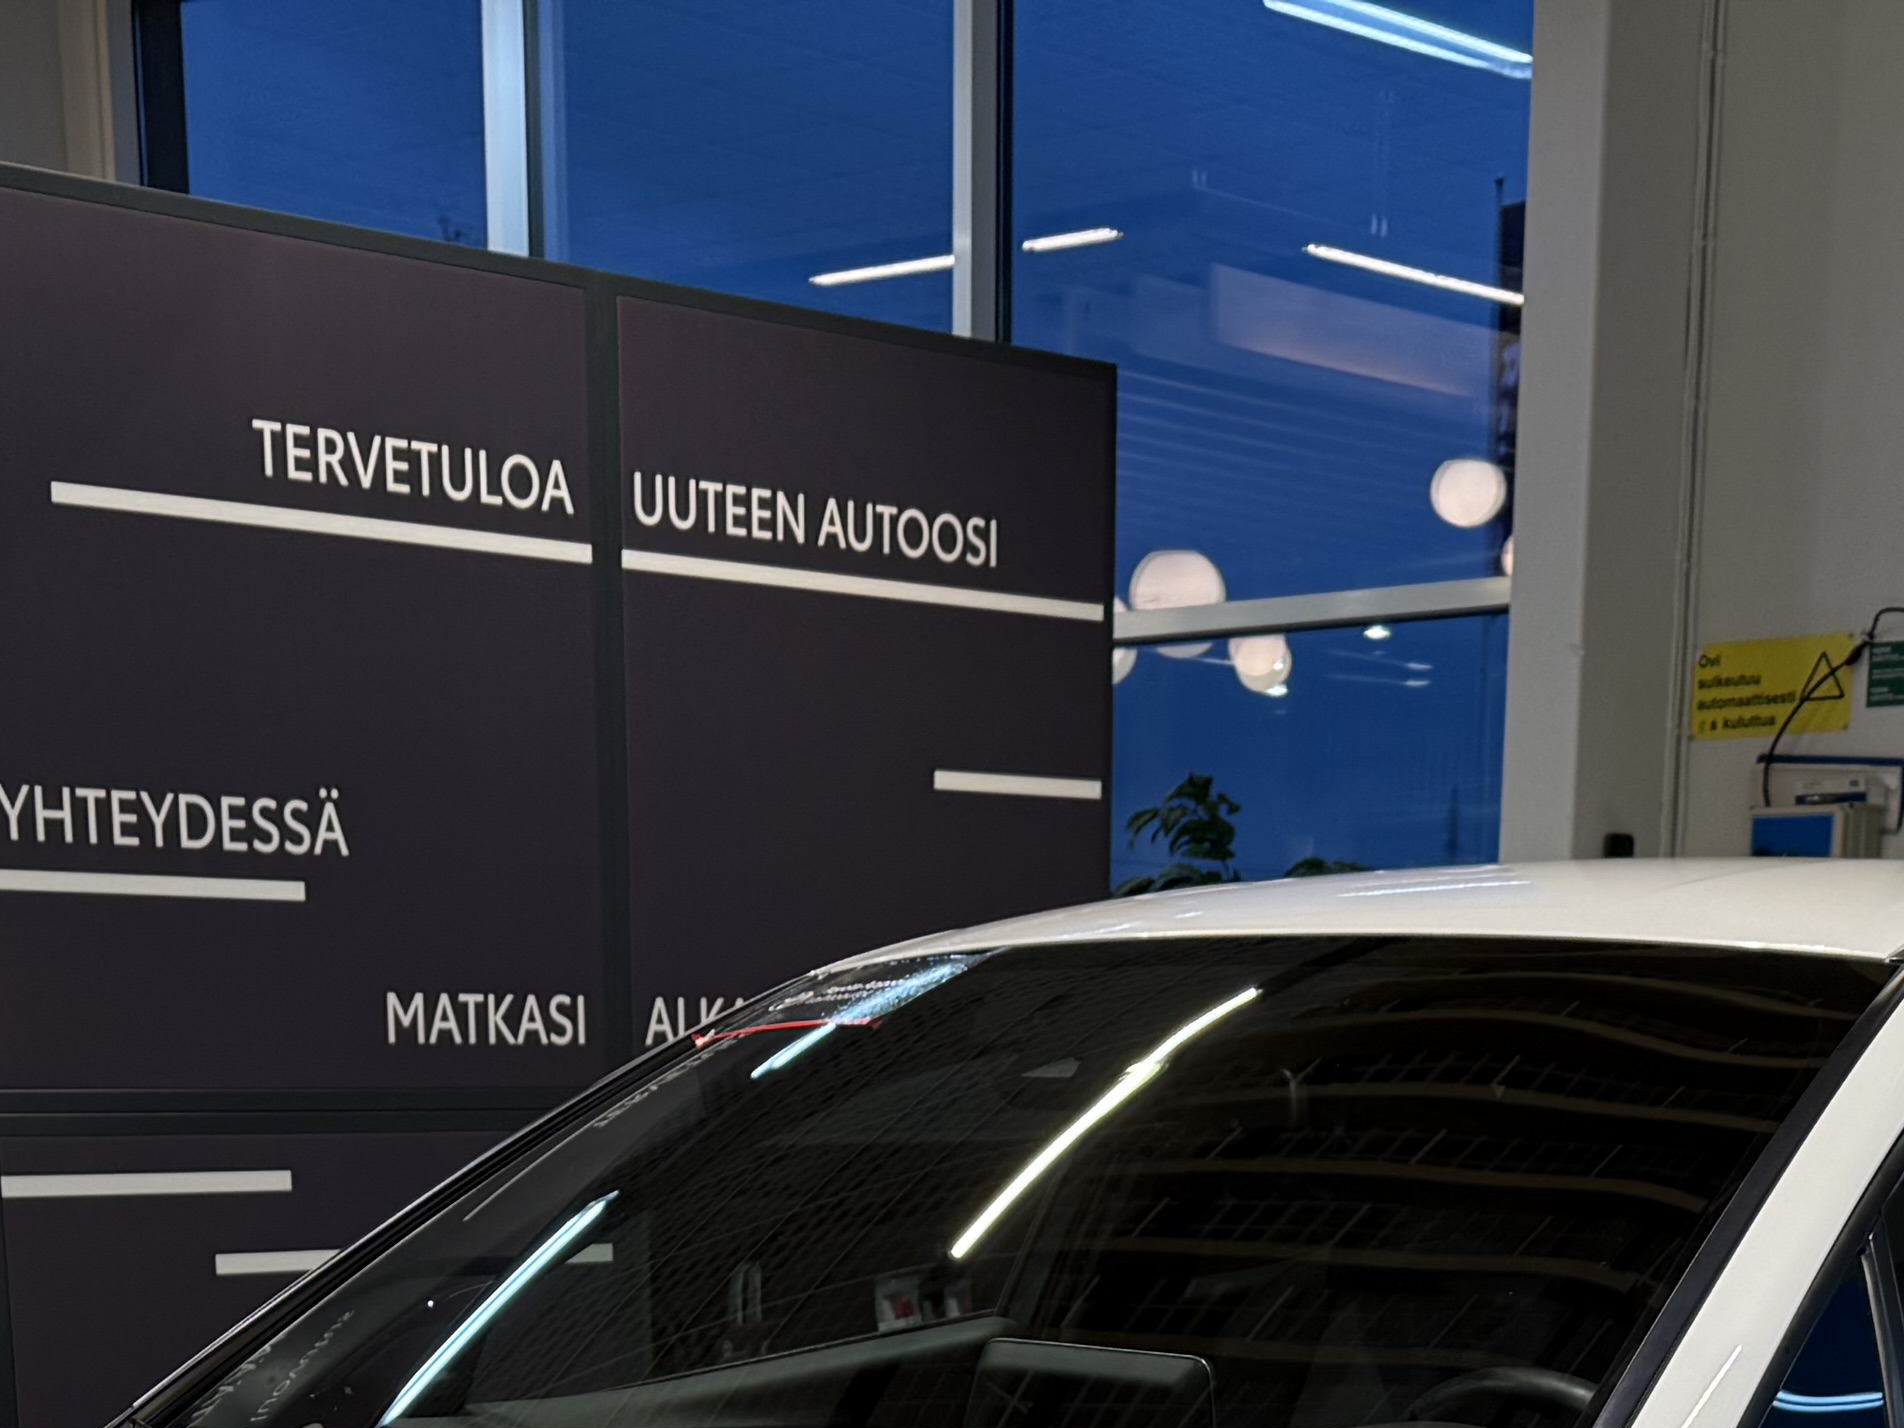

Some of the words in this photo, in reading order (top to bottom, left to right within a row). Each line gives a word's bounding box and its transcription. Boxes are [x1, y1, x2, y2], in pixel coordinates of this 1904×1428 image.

[252, 417, 574, 515] TERVETULOA
[632, 471, 806, 545] UUTEEN
[817, 489, 999, 568] AUTOOSI
[386, 992, 588, 1047] MATKASI
[645, 996, 745, 1047] ALK
